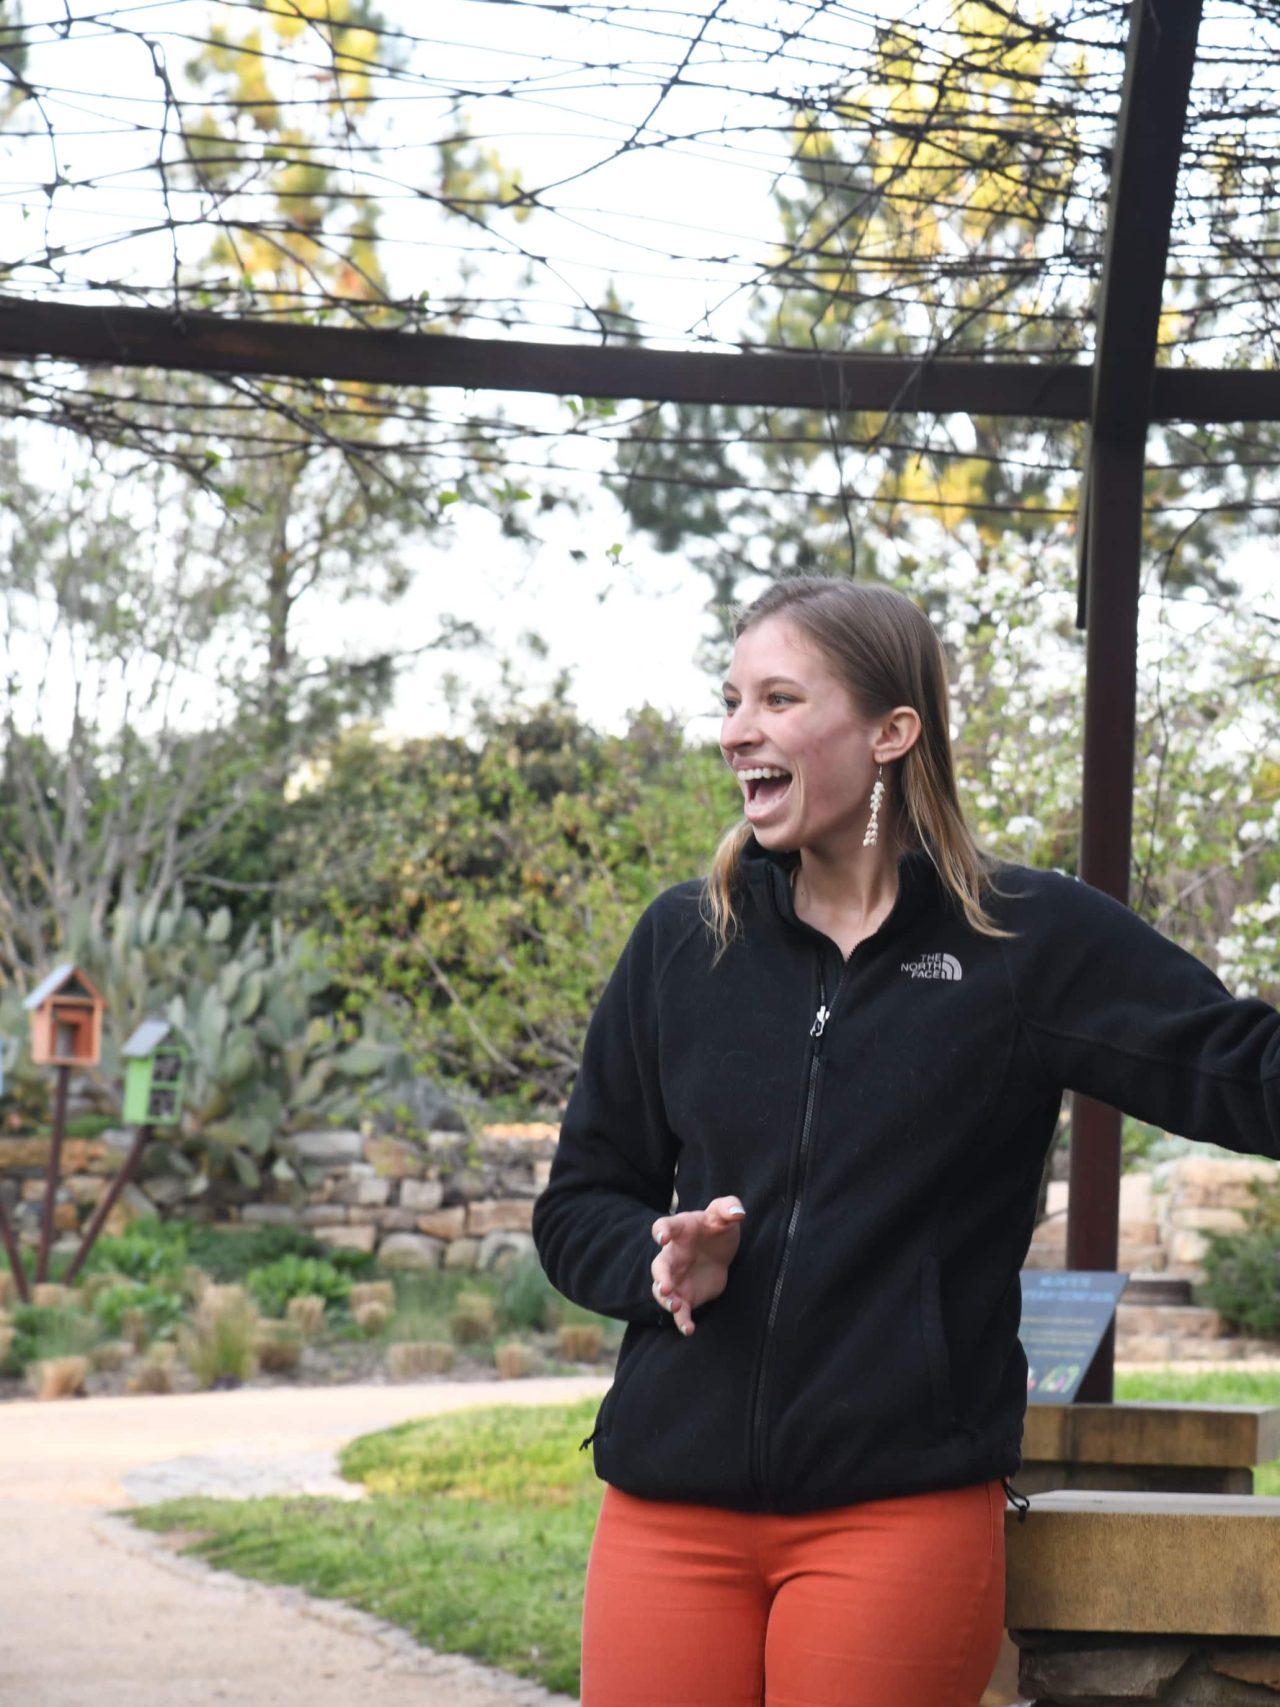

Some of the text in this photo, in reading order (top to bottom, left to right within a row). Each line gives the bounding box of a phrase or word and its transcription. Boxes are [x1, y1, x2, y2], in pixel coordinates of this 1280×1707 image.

[921, 953, 942, 963] THE
[901, 961, 941, 972] NORTH
[911, 970, 941, 979] FACE
